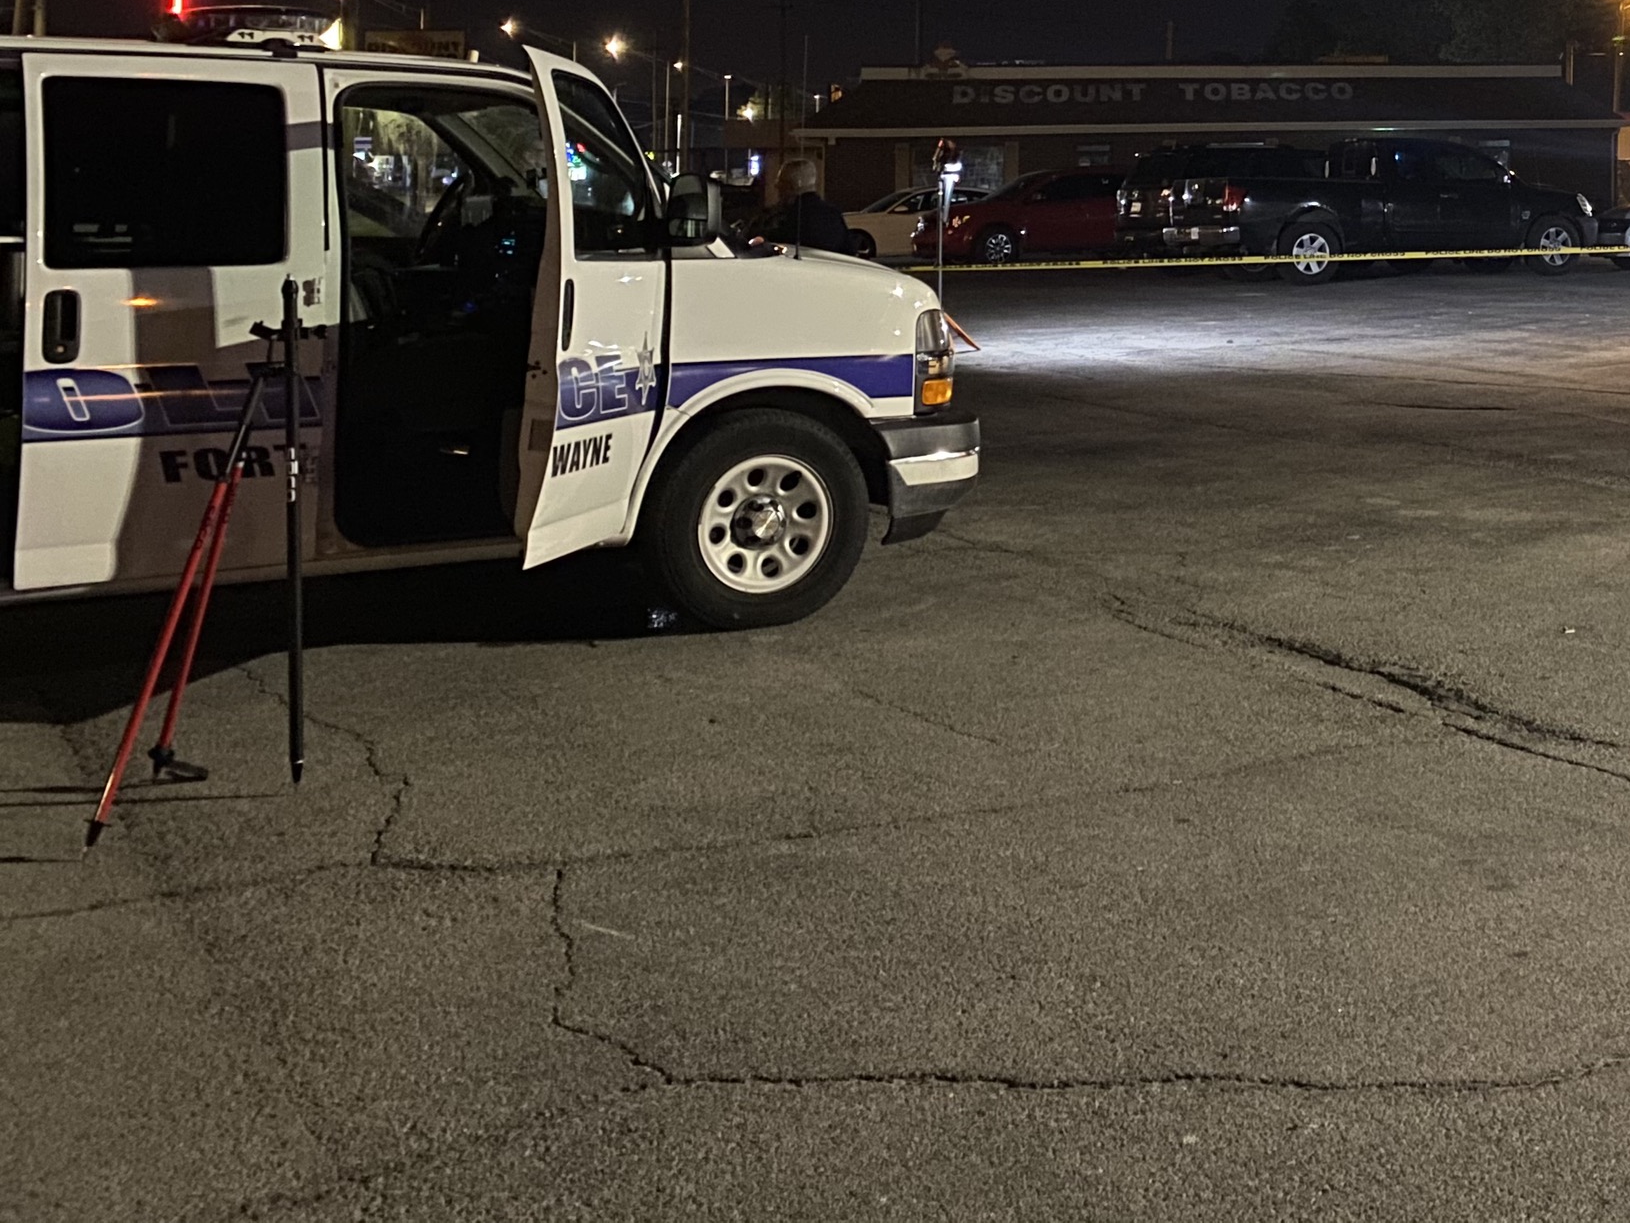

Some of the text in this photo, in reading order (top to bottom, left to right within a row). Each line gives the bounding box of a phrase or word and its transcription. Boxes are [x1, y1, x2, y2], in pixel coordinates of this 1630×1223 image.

[951, 81, 1354, 104] DISCOUNT TOBACCO
[551, 433, 613, 478] WAYNE
